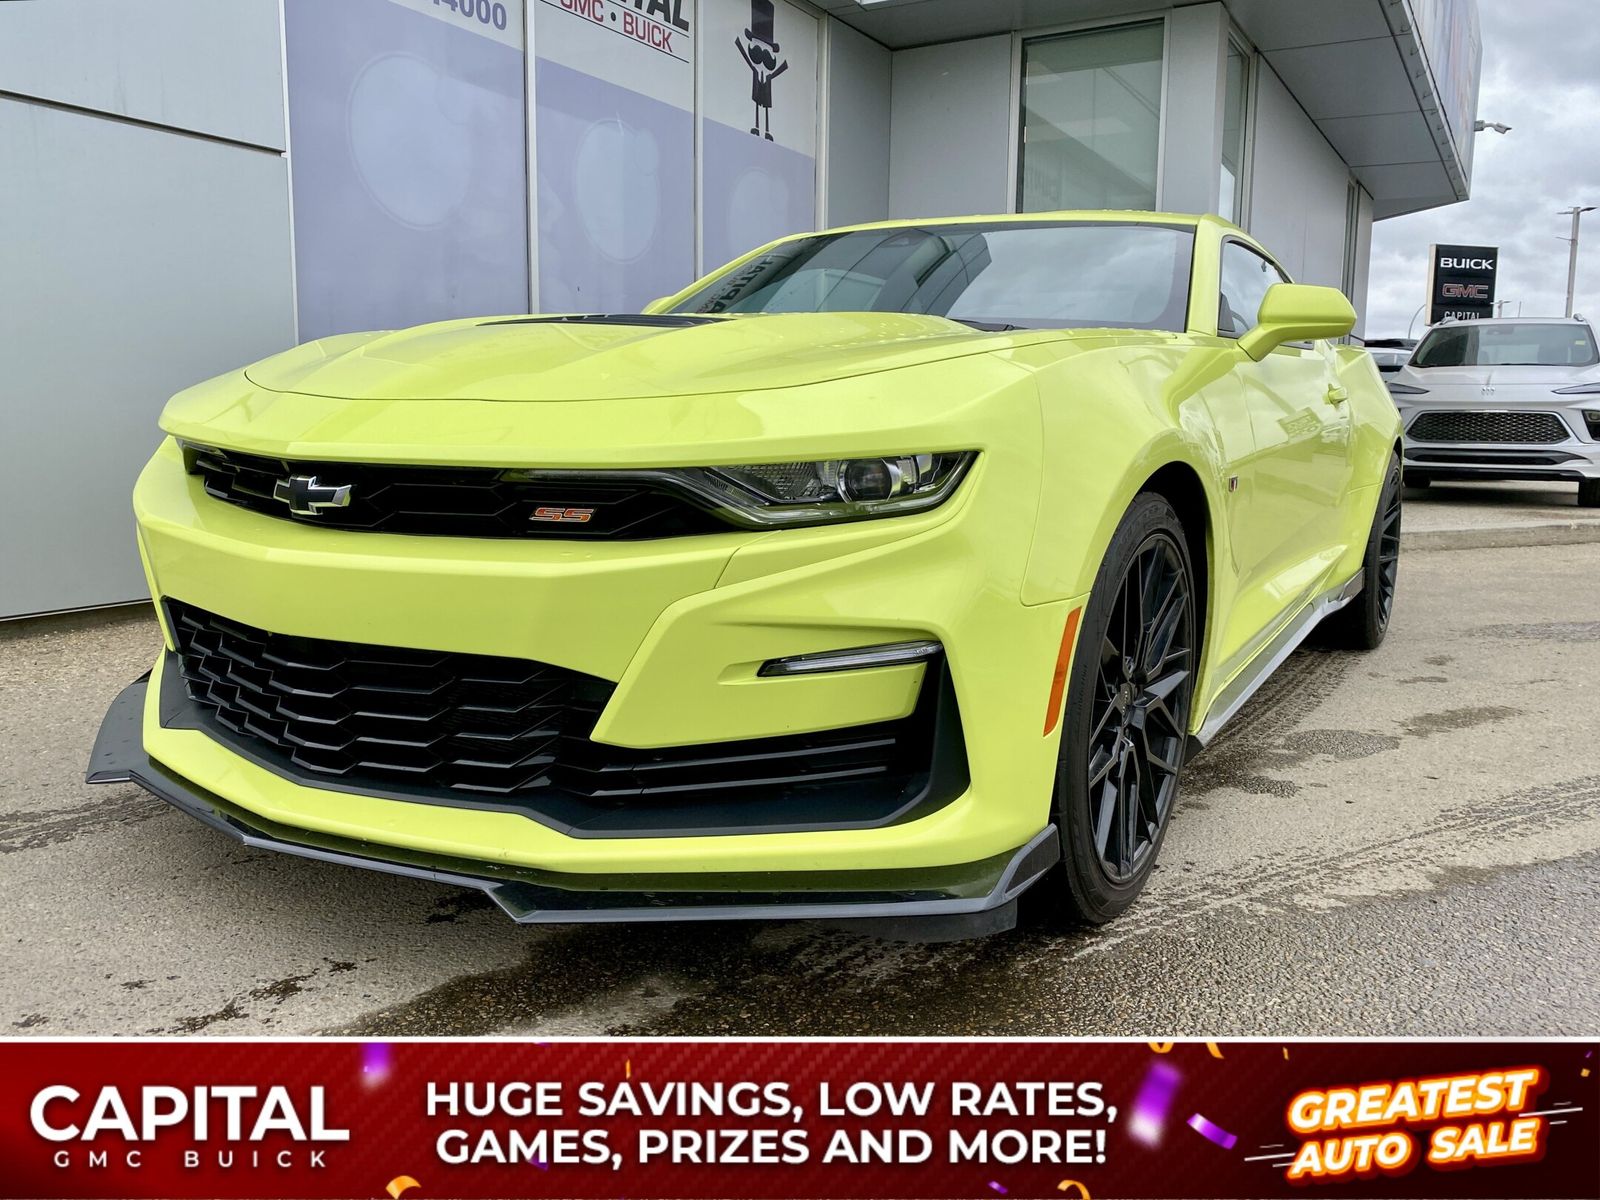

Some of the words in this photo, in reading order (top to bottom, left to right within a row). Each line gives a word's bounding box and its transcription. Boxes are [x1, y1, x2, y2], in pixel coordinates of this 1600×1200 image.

[623, 11, 673, 53] BUICK
[1440, 258, 1494, 270] BUICK
[1442, 283, 1489, 299] GMC
[528, 507, 595, 523] SS
